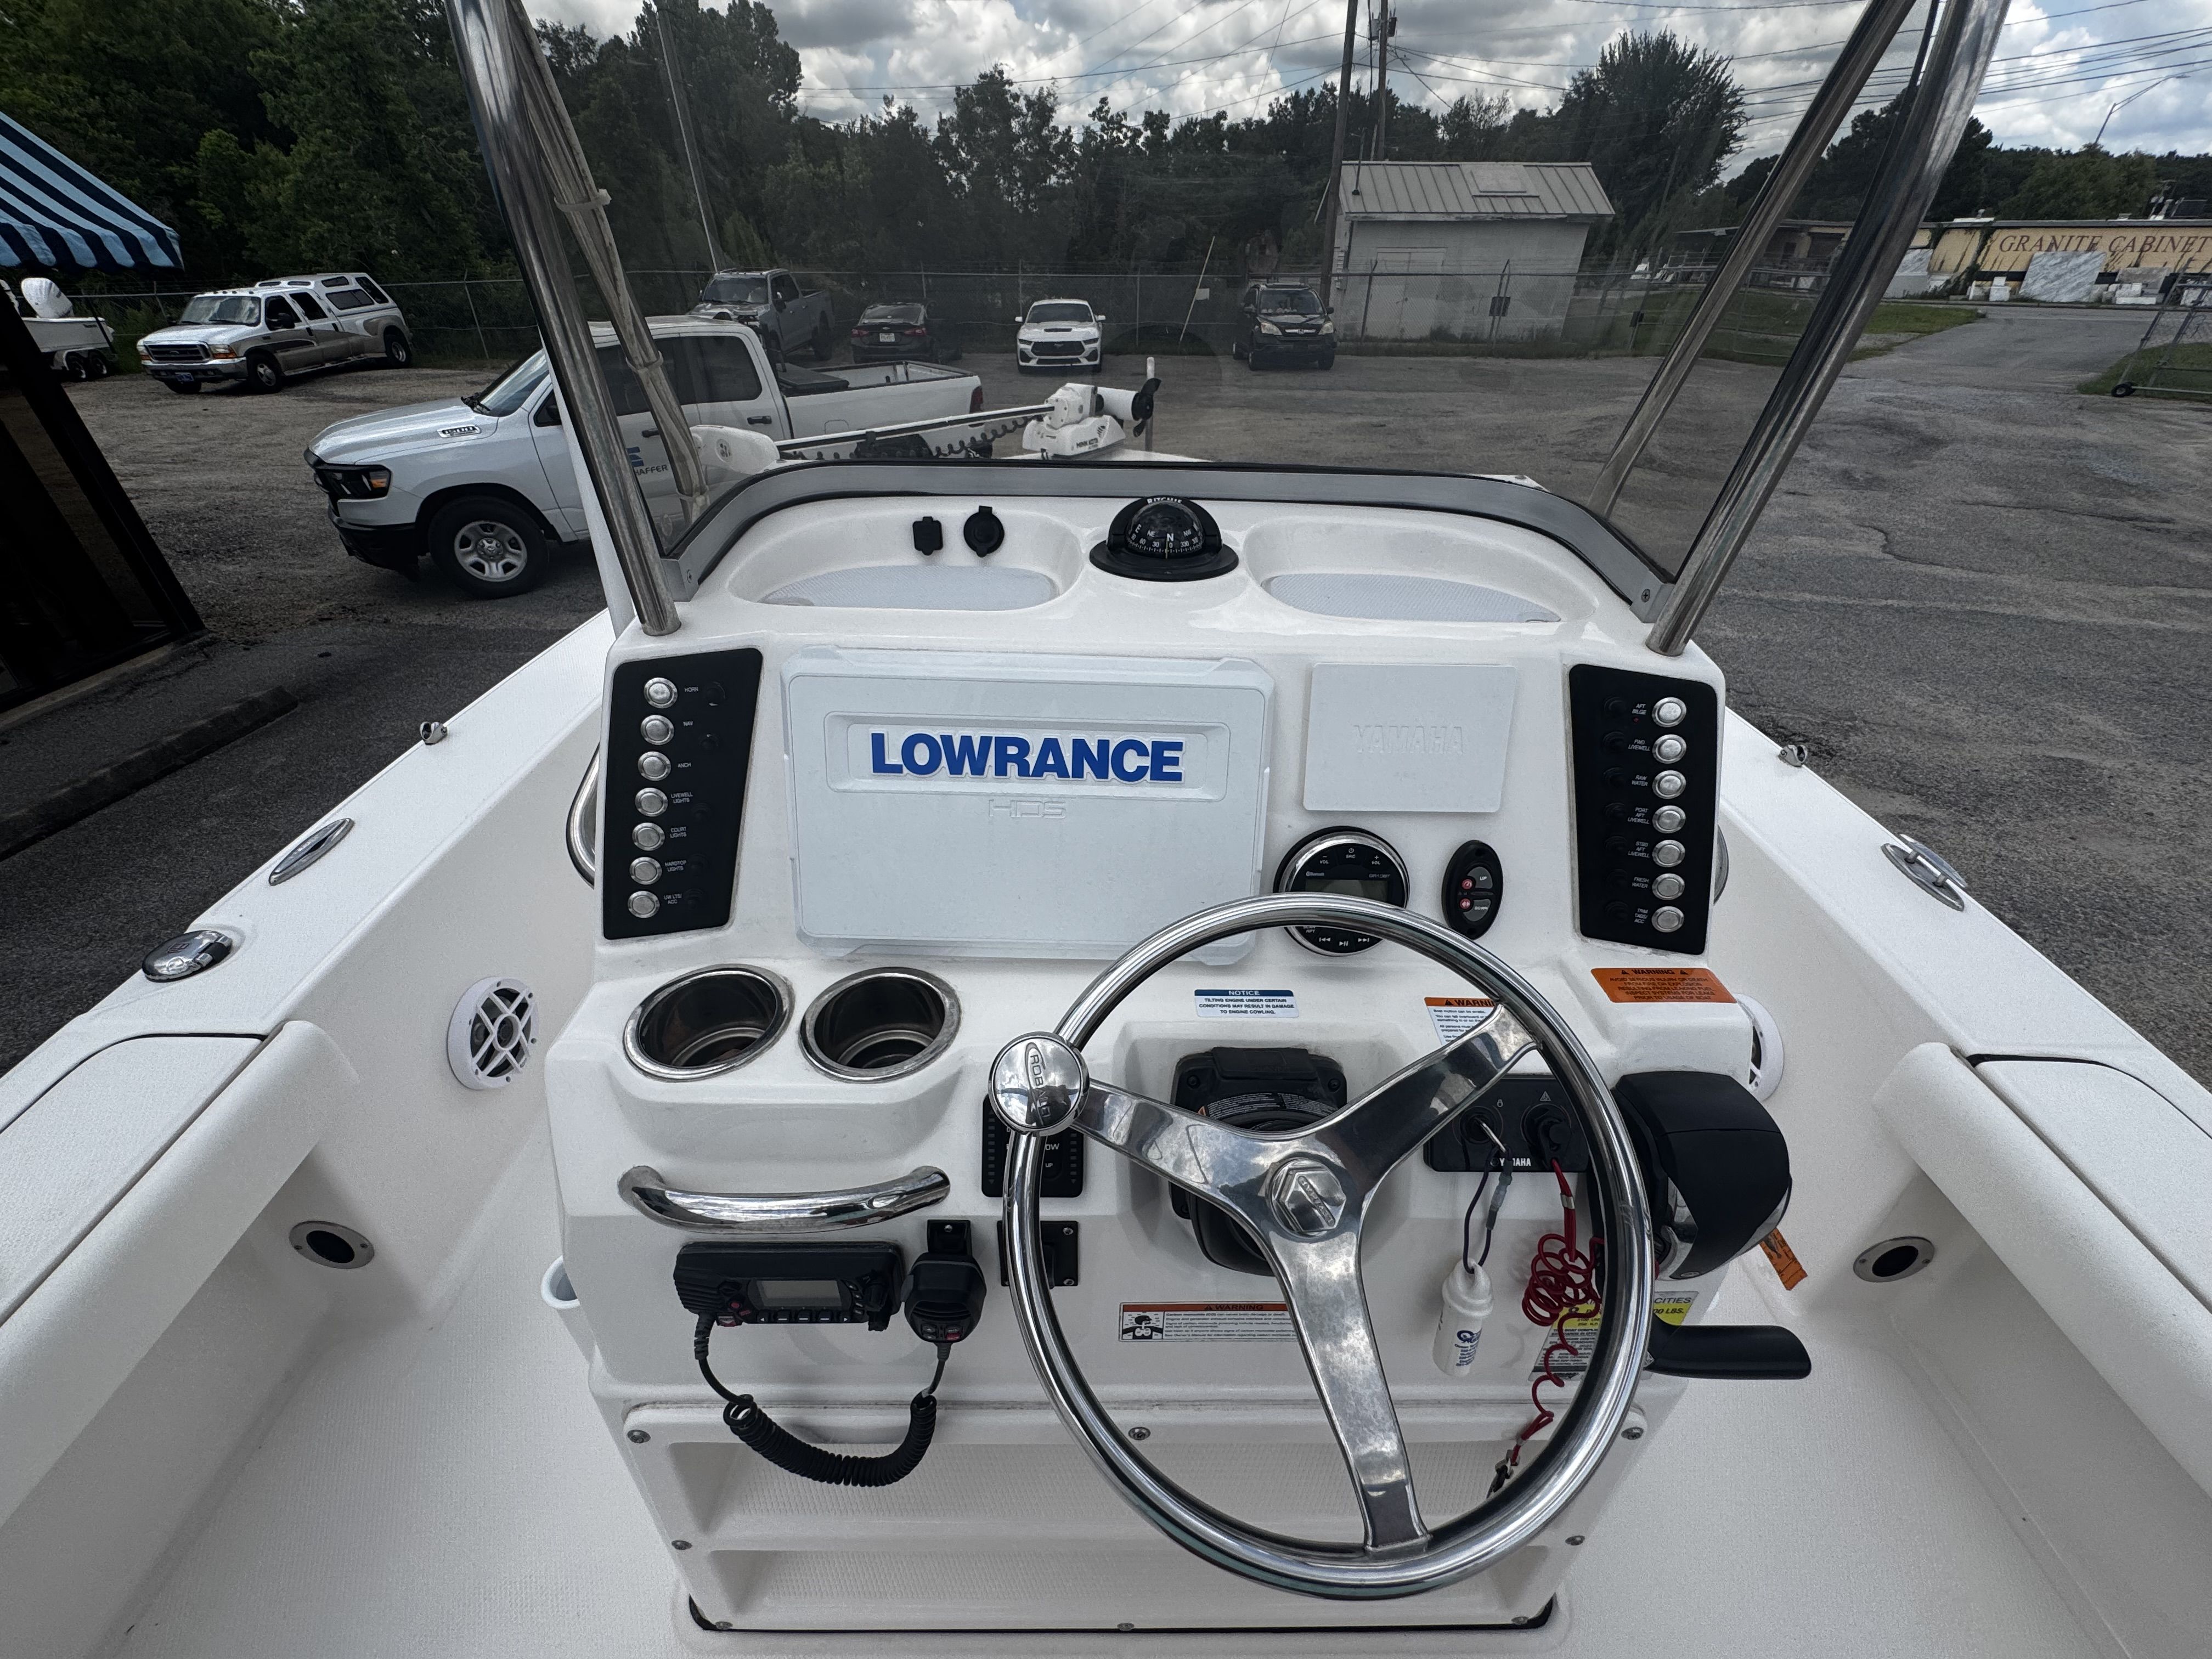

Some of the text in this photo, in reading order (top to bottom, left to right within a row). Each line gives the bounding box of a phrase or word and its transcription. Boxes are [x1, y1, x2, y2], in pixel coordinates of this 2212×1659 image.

[1999, 235, 2103, 253] GRANITE
[636, 464, 668, 475] HAFFER
[1167, 533, 1174, 541] N
[1183, 529, 1192, 537] NW
[1353, 725, 1464, 754] YAMAHA
[871, 733, 1183, 782] LOWRANCE
[988, 798, 1067, 820] HDS
[1499, 1158, 1532, 1167] YAHA
